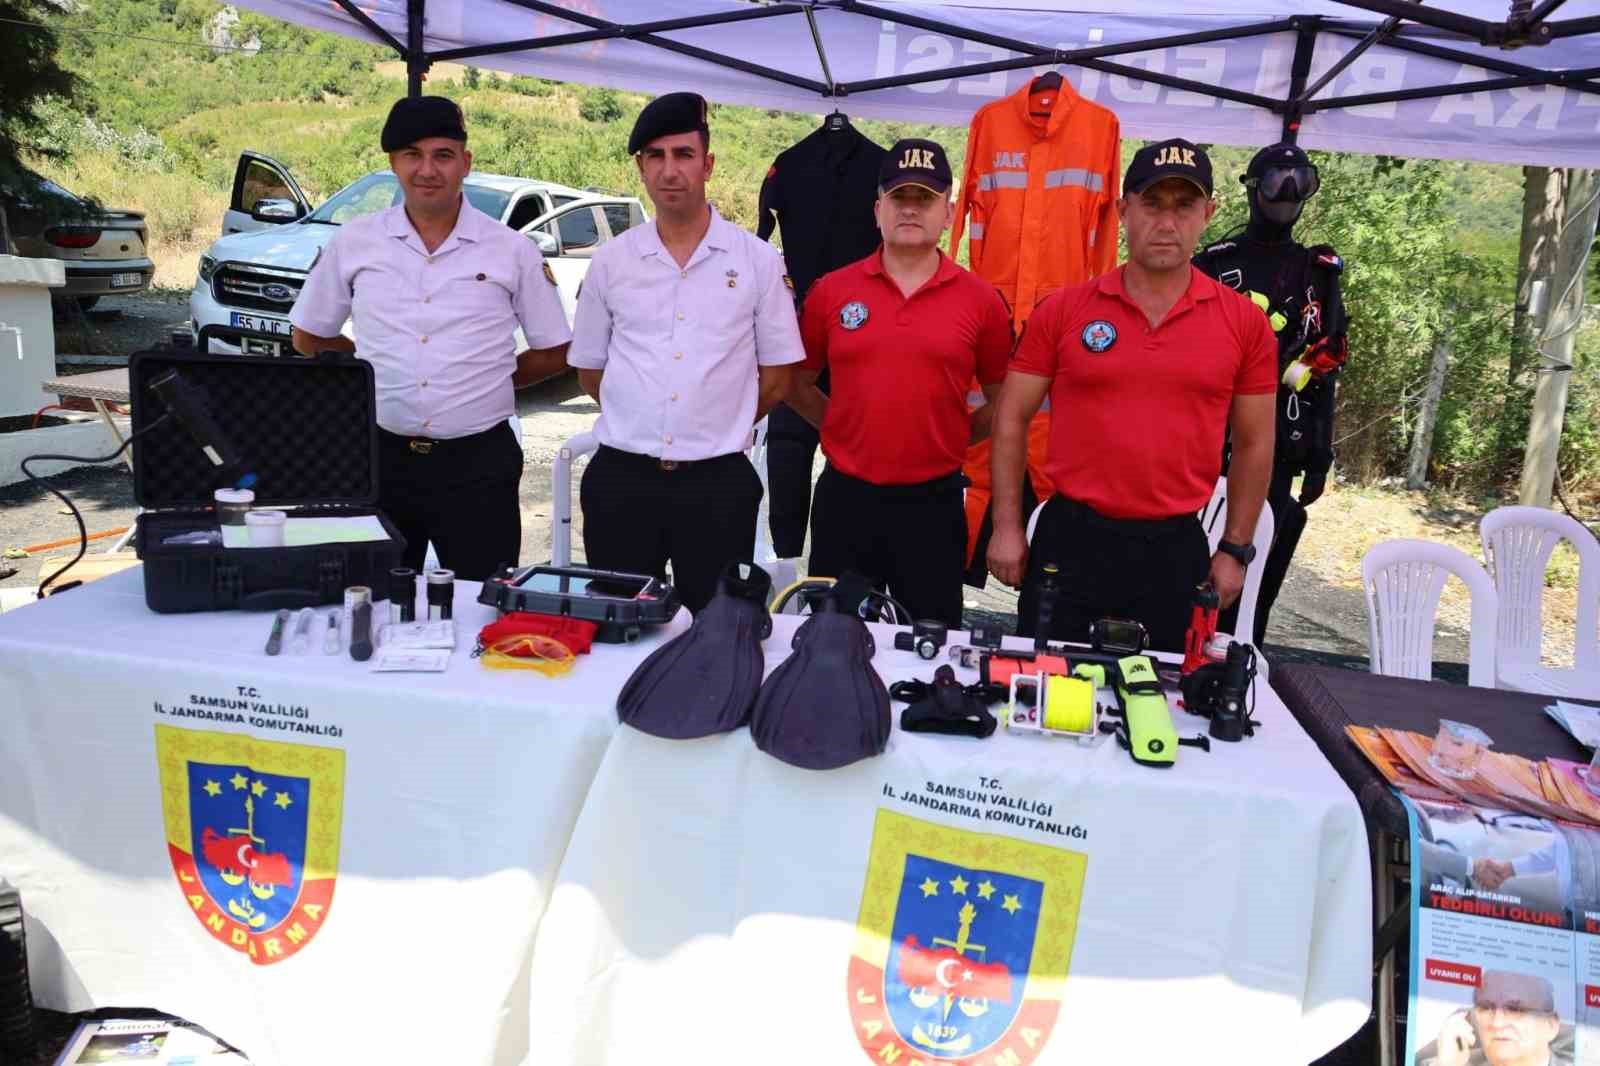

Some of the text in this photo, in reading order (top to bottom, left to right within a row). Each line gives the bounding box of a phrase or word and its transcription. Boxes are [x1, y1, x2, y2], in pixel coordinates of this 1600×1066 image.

[899, 148, 935, 170] JAK
[992, 151, 1025, 168] JAK
[1154, 145, 1196, 167] JAK
[237, 686, 262, 700] T.C.
[154, 701, 166, 714] İL
[170, 706, 245, 724] JANDARMA
[190, 694, 309, 719] SAMSUN VALİLİĞİ
[979, 776, 1003, 791] T.C.
[926, 780, 1053, 818] SAMSUN VALİLİĞİ
[882, 783, 1088, 841] İL JANDARMA KOMUTANLIĞI
